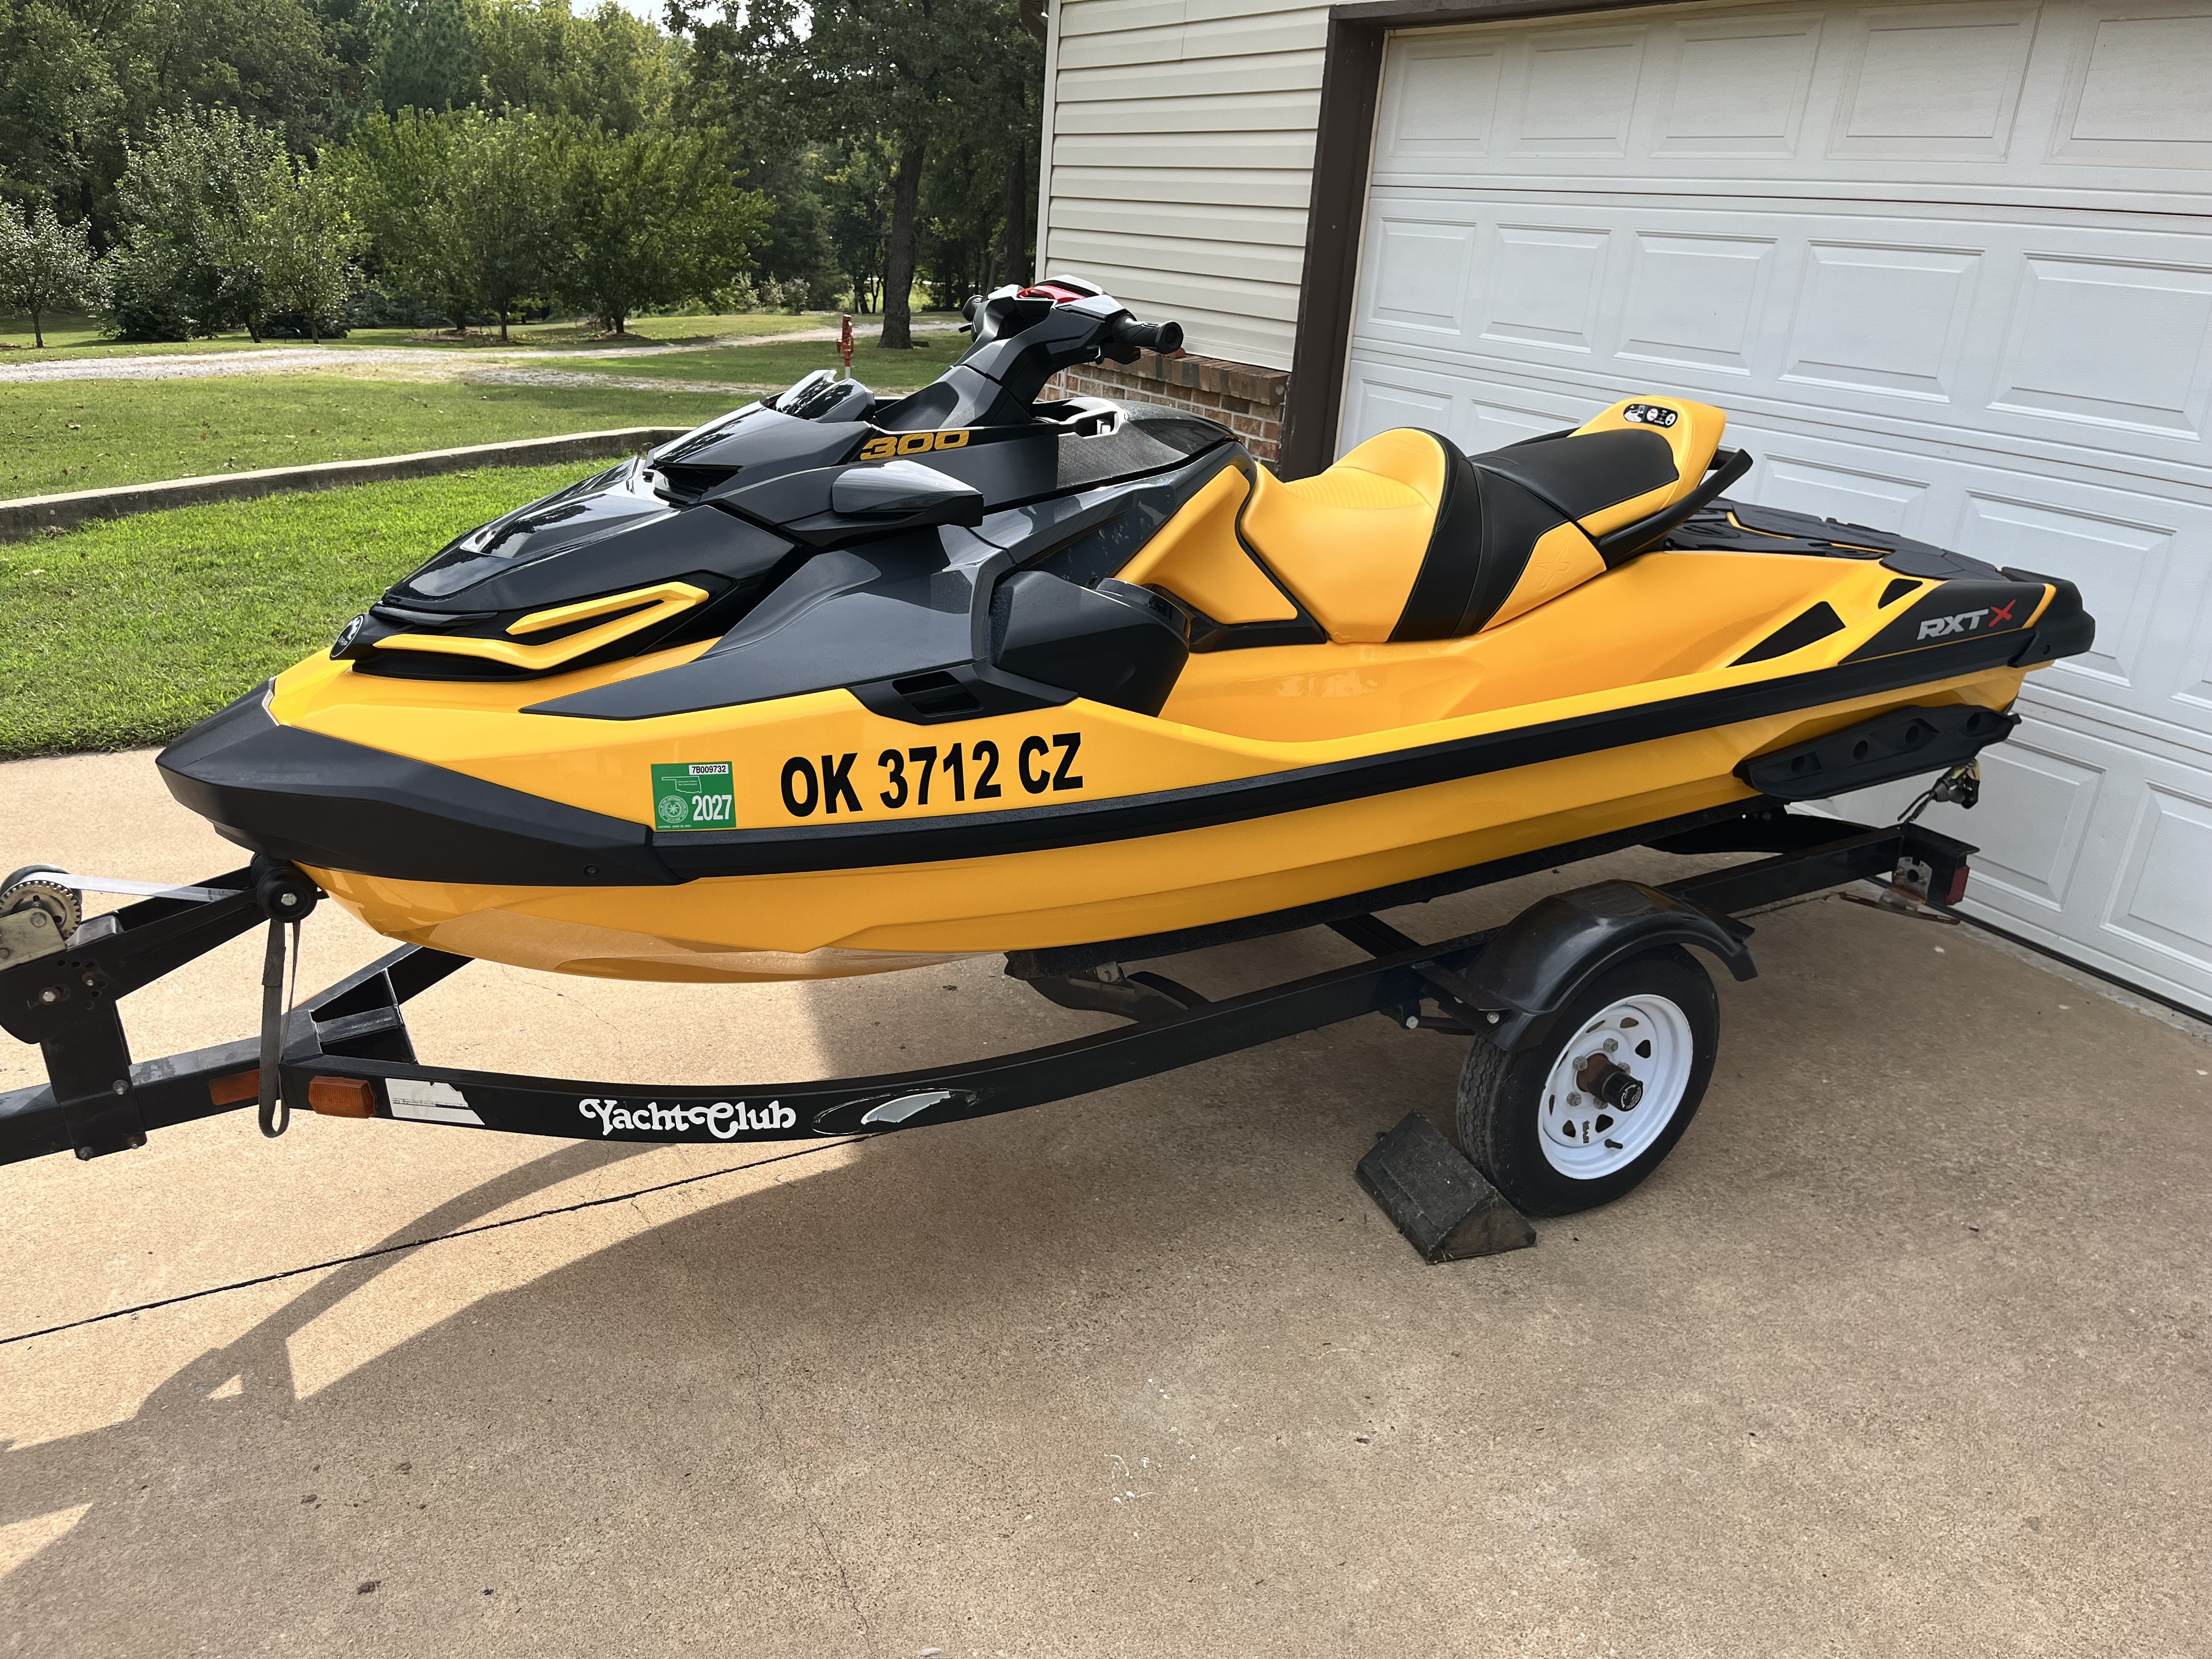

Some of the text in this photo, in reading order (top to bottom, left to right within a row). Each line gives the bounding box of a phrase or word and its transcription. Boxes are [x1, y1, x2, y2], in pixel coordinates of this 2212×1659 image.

[860, 430, 969, 460] 300
[692, 765, 726, 774] 7B009732
[781, 732, 1084, 817] OK 3712 CZ
[692, 794, 732, 821] 2027
